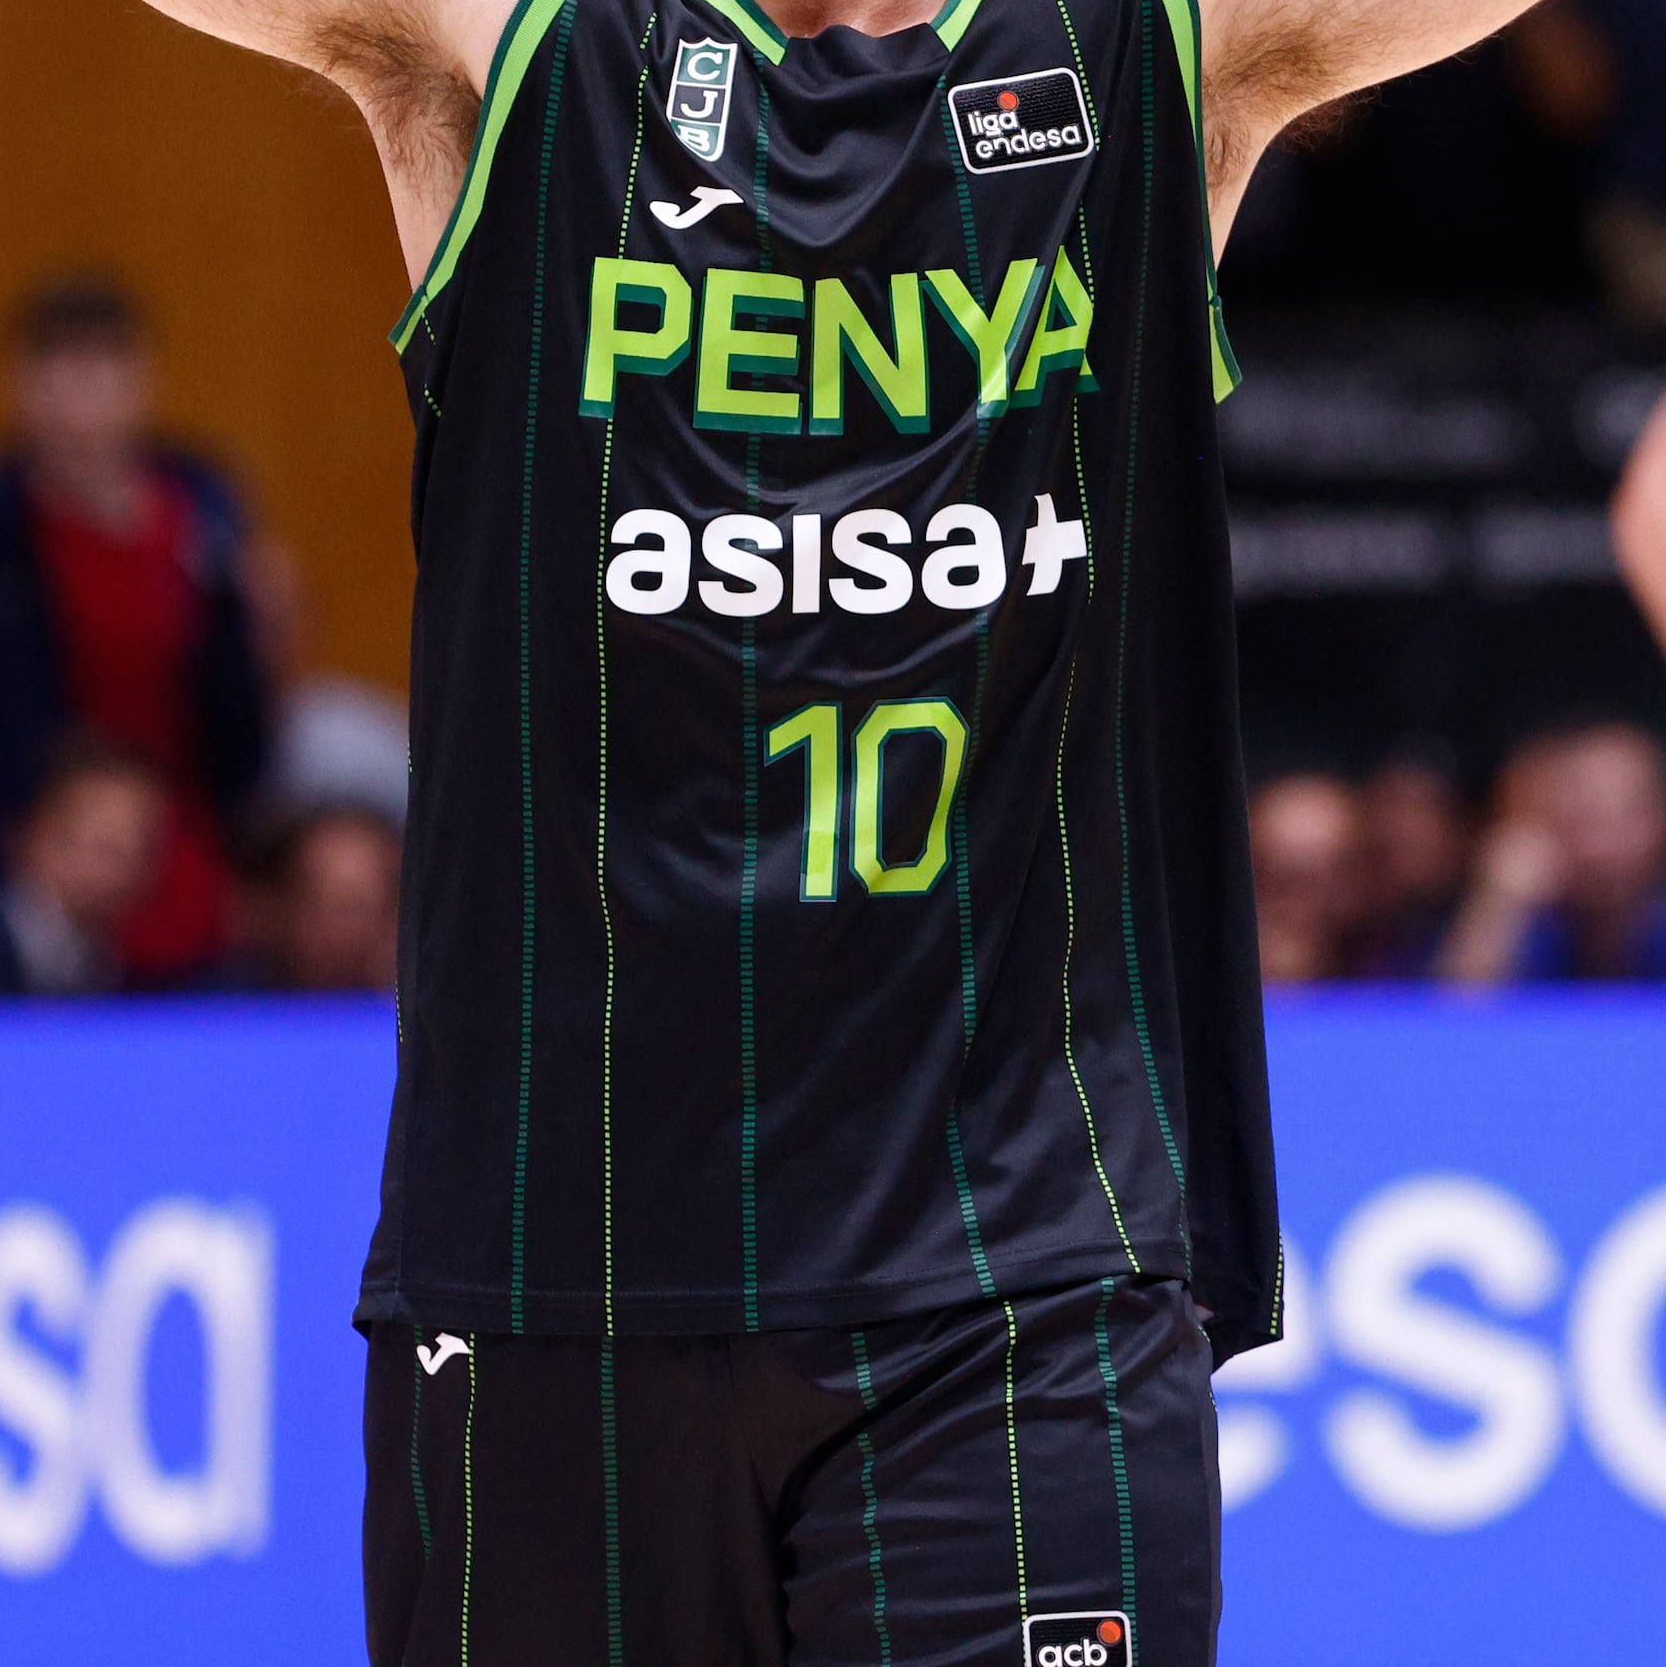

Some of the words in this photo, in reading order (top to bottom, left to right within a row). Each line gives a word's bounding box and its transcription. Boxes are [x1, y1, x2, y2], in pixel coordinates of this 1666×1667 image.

[967, 110, 1018, 136] liga
[975, 125, 1082, 159] endesa
[579, 245, 1100, 435] PENYA
[763, 696, 971, 903] 10
[1038, 1638, 1108, 1667] acb
